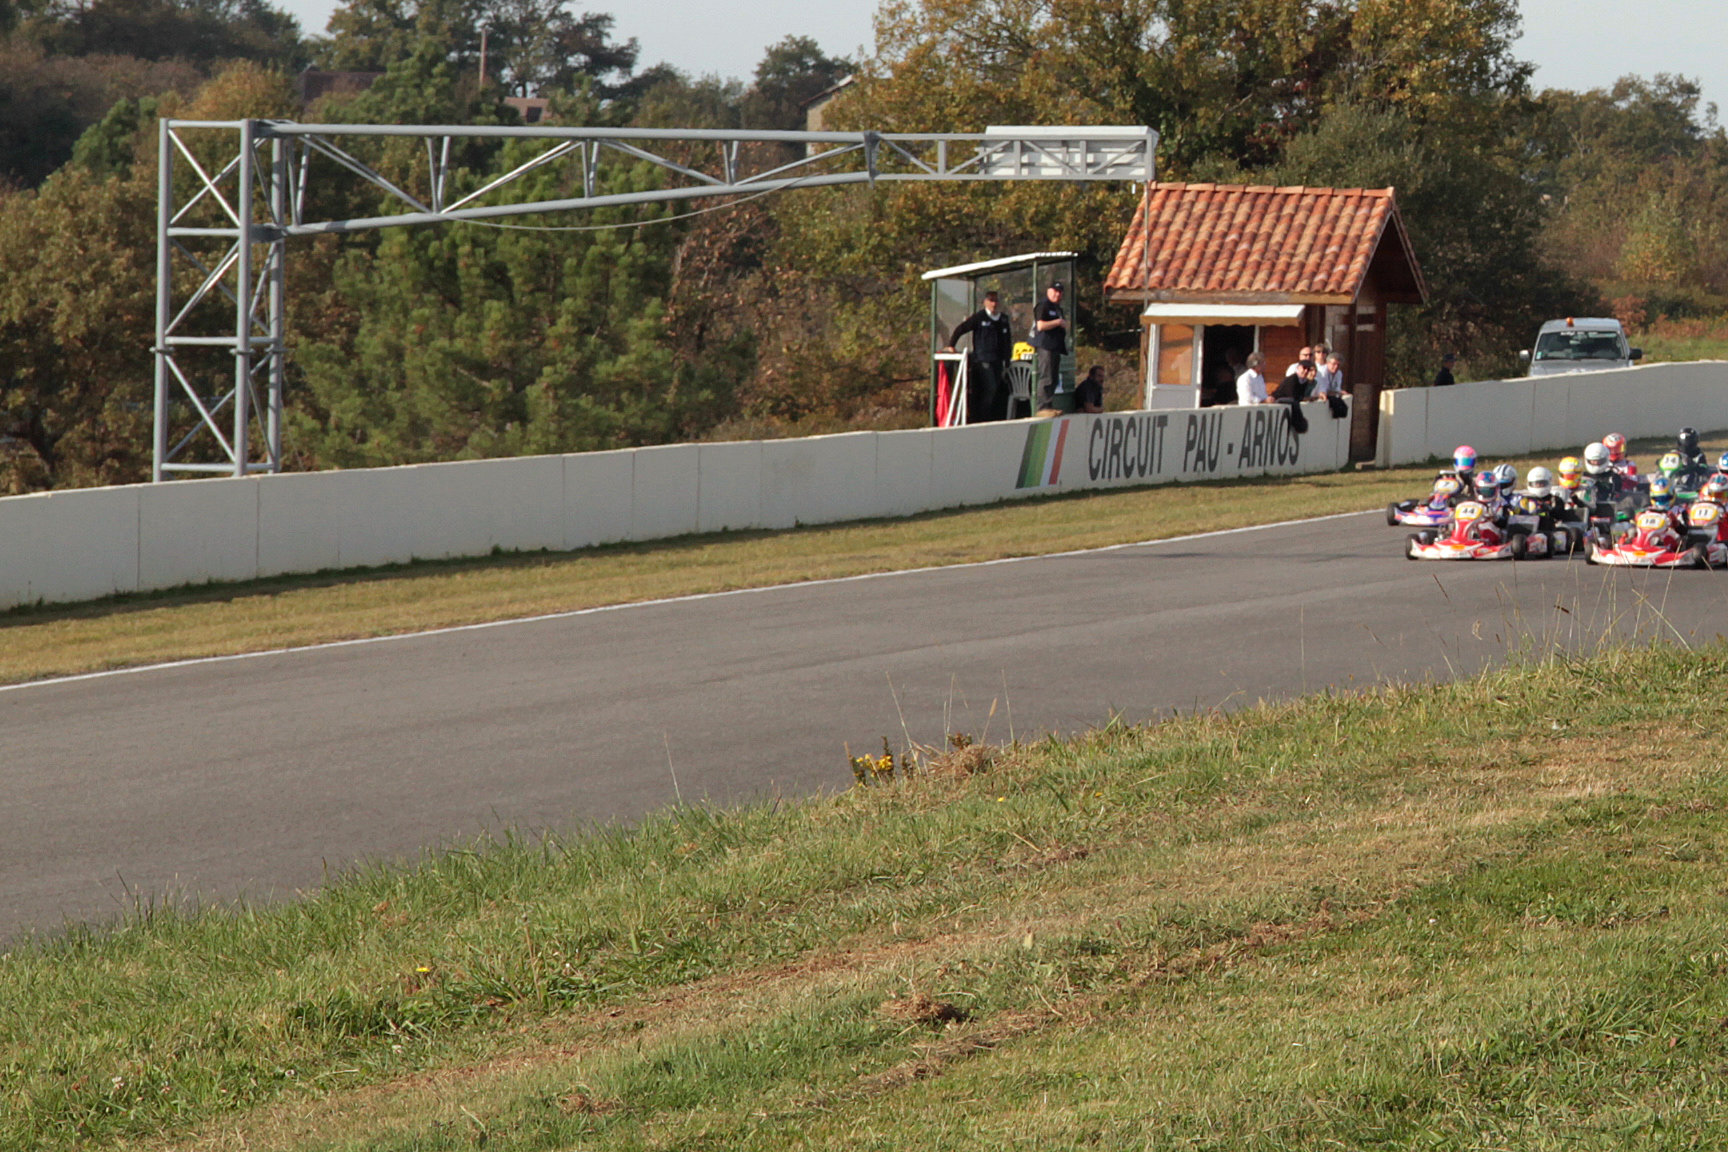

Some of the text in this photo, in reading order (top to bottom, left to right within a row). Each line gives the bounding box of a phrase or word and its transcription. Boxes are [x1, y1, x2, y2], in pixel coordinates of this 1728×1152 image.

[1088, 414, 1169, 482] CIRCUIT
[1183, 412, 1223, 473] PAU
[1238, 407, 1300, 471] ARNOS
[1462, 506, 1476, 515] 44
